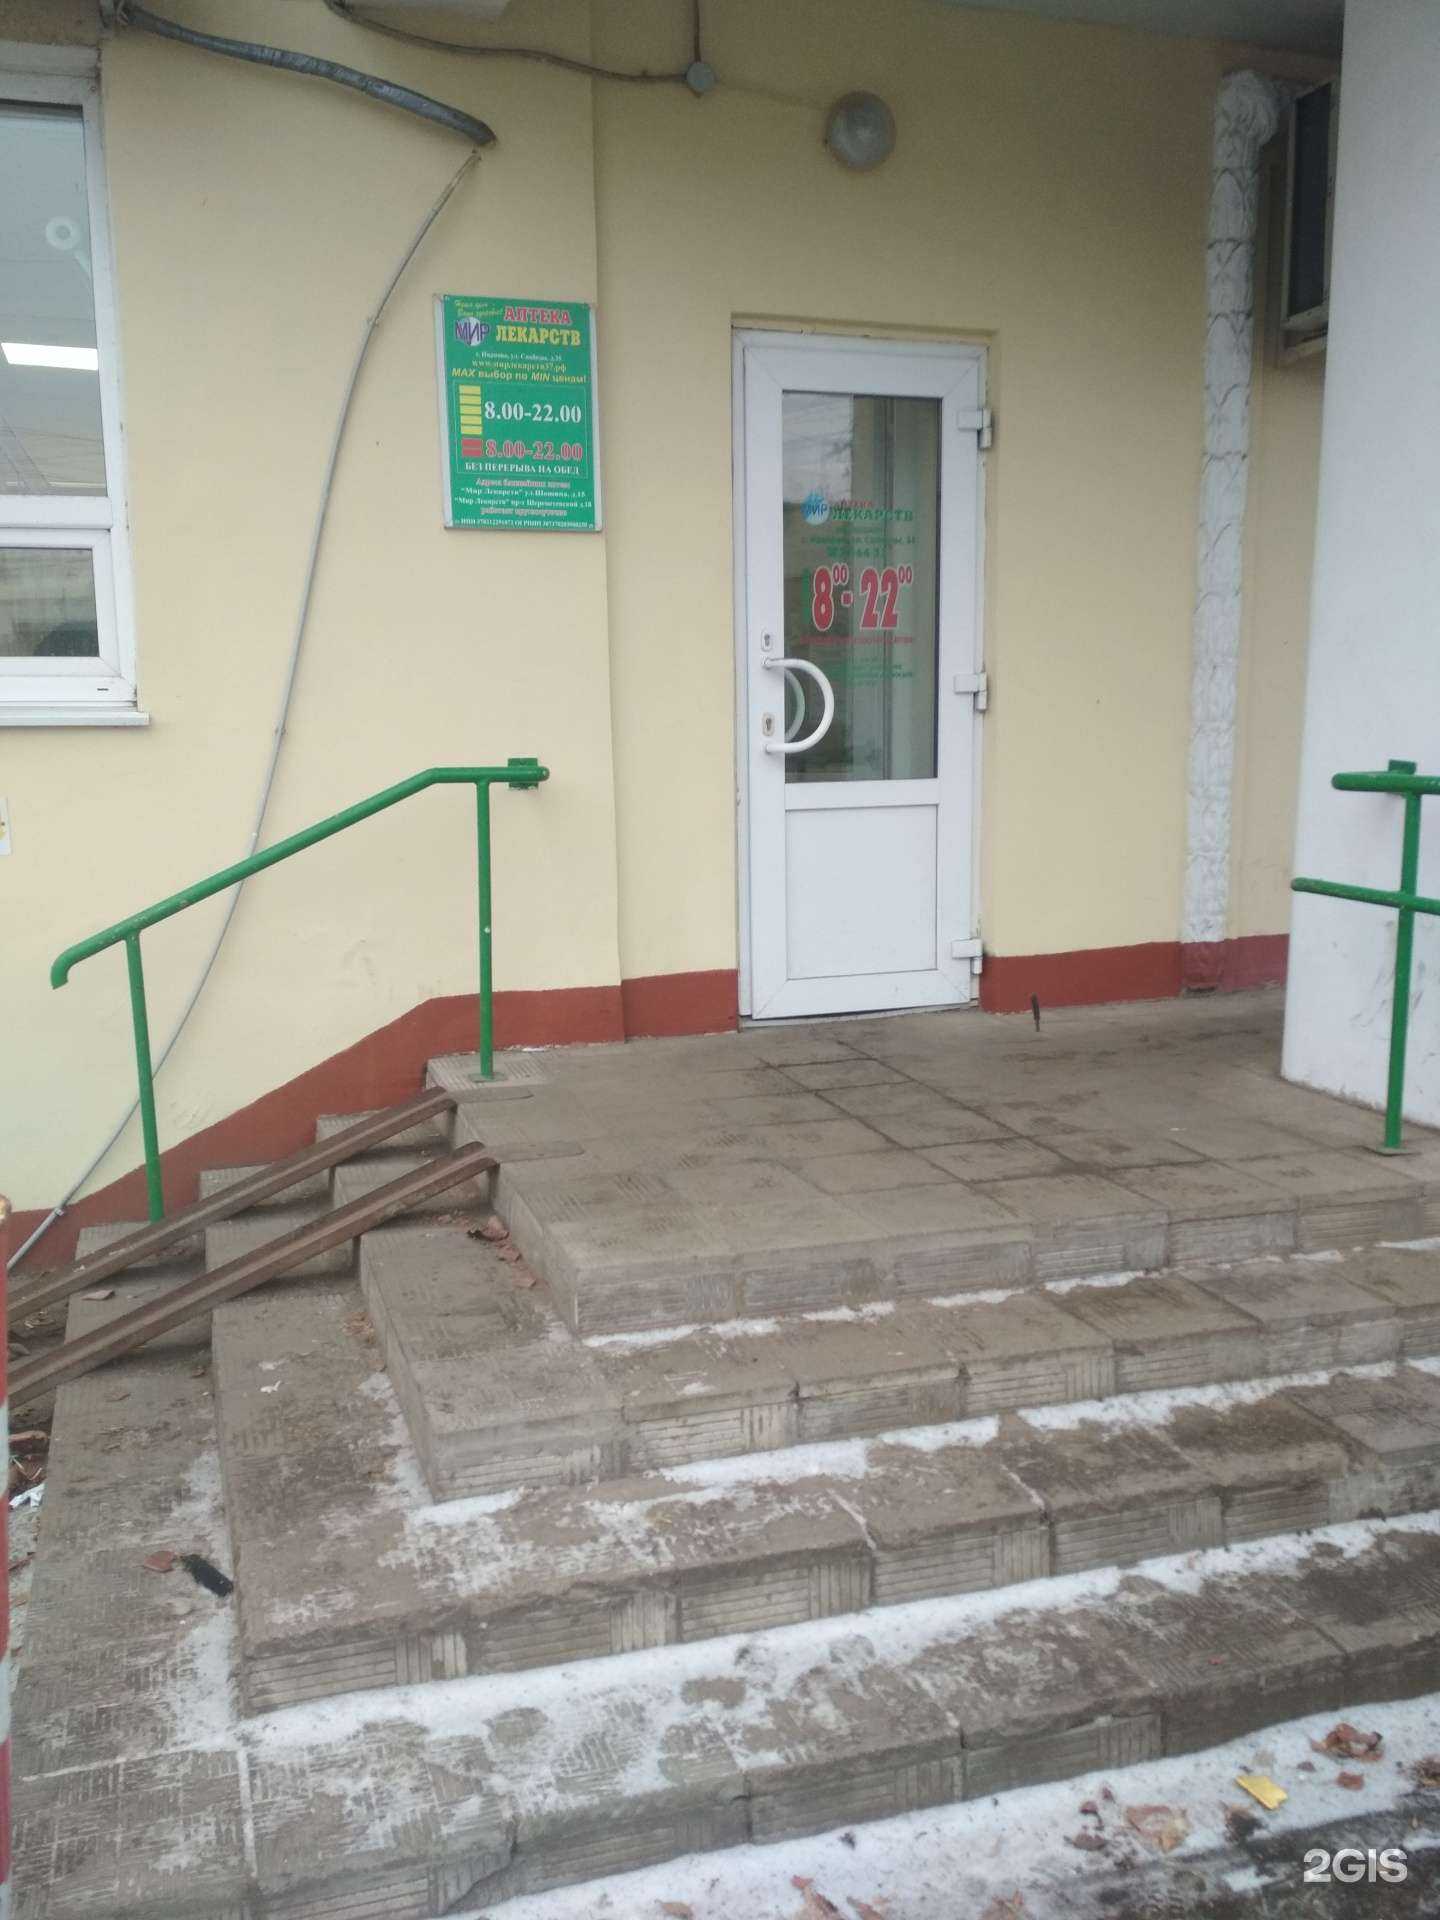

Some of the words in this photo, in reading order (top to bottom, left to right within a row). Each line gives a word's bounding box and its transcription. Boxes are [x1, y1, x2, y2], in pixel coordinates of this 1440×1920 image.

[503, 306, 572, 325] АПТЕКА
[455, 321, 490, 346] МИР
[495, 325, 581, 346] ЛЕКАРСТВ
[479, 370, 512, 381] выбор
[515, 372, 528, 381] по
[531, 372, 550, 382] MIN
[484, 401, 582, 423] 8.00-22.00
[485, 439, 583, 462] 8.00-22.00
[465, 462, 483, 471] БЕЗ
[485, 463, 536, 473] ПЕРЕРЫВА
[538, 465, 552, 473] НА
[553, 465, 580, 475] ОБЕД
